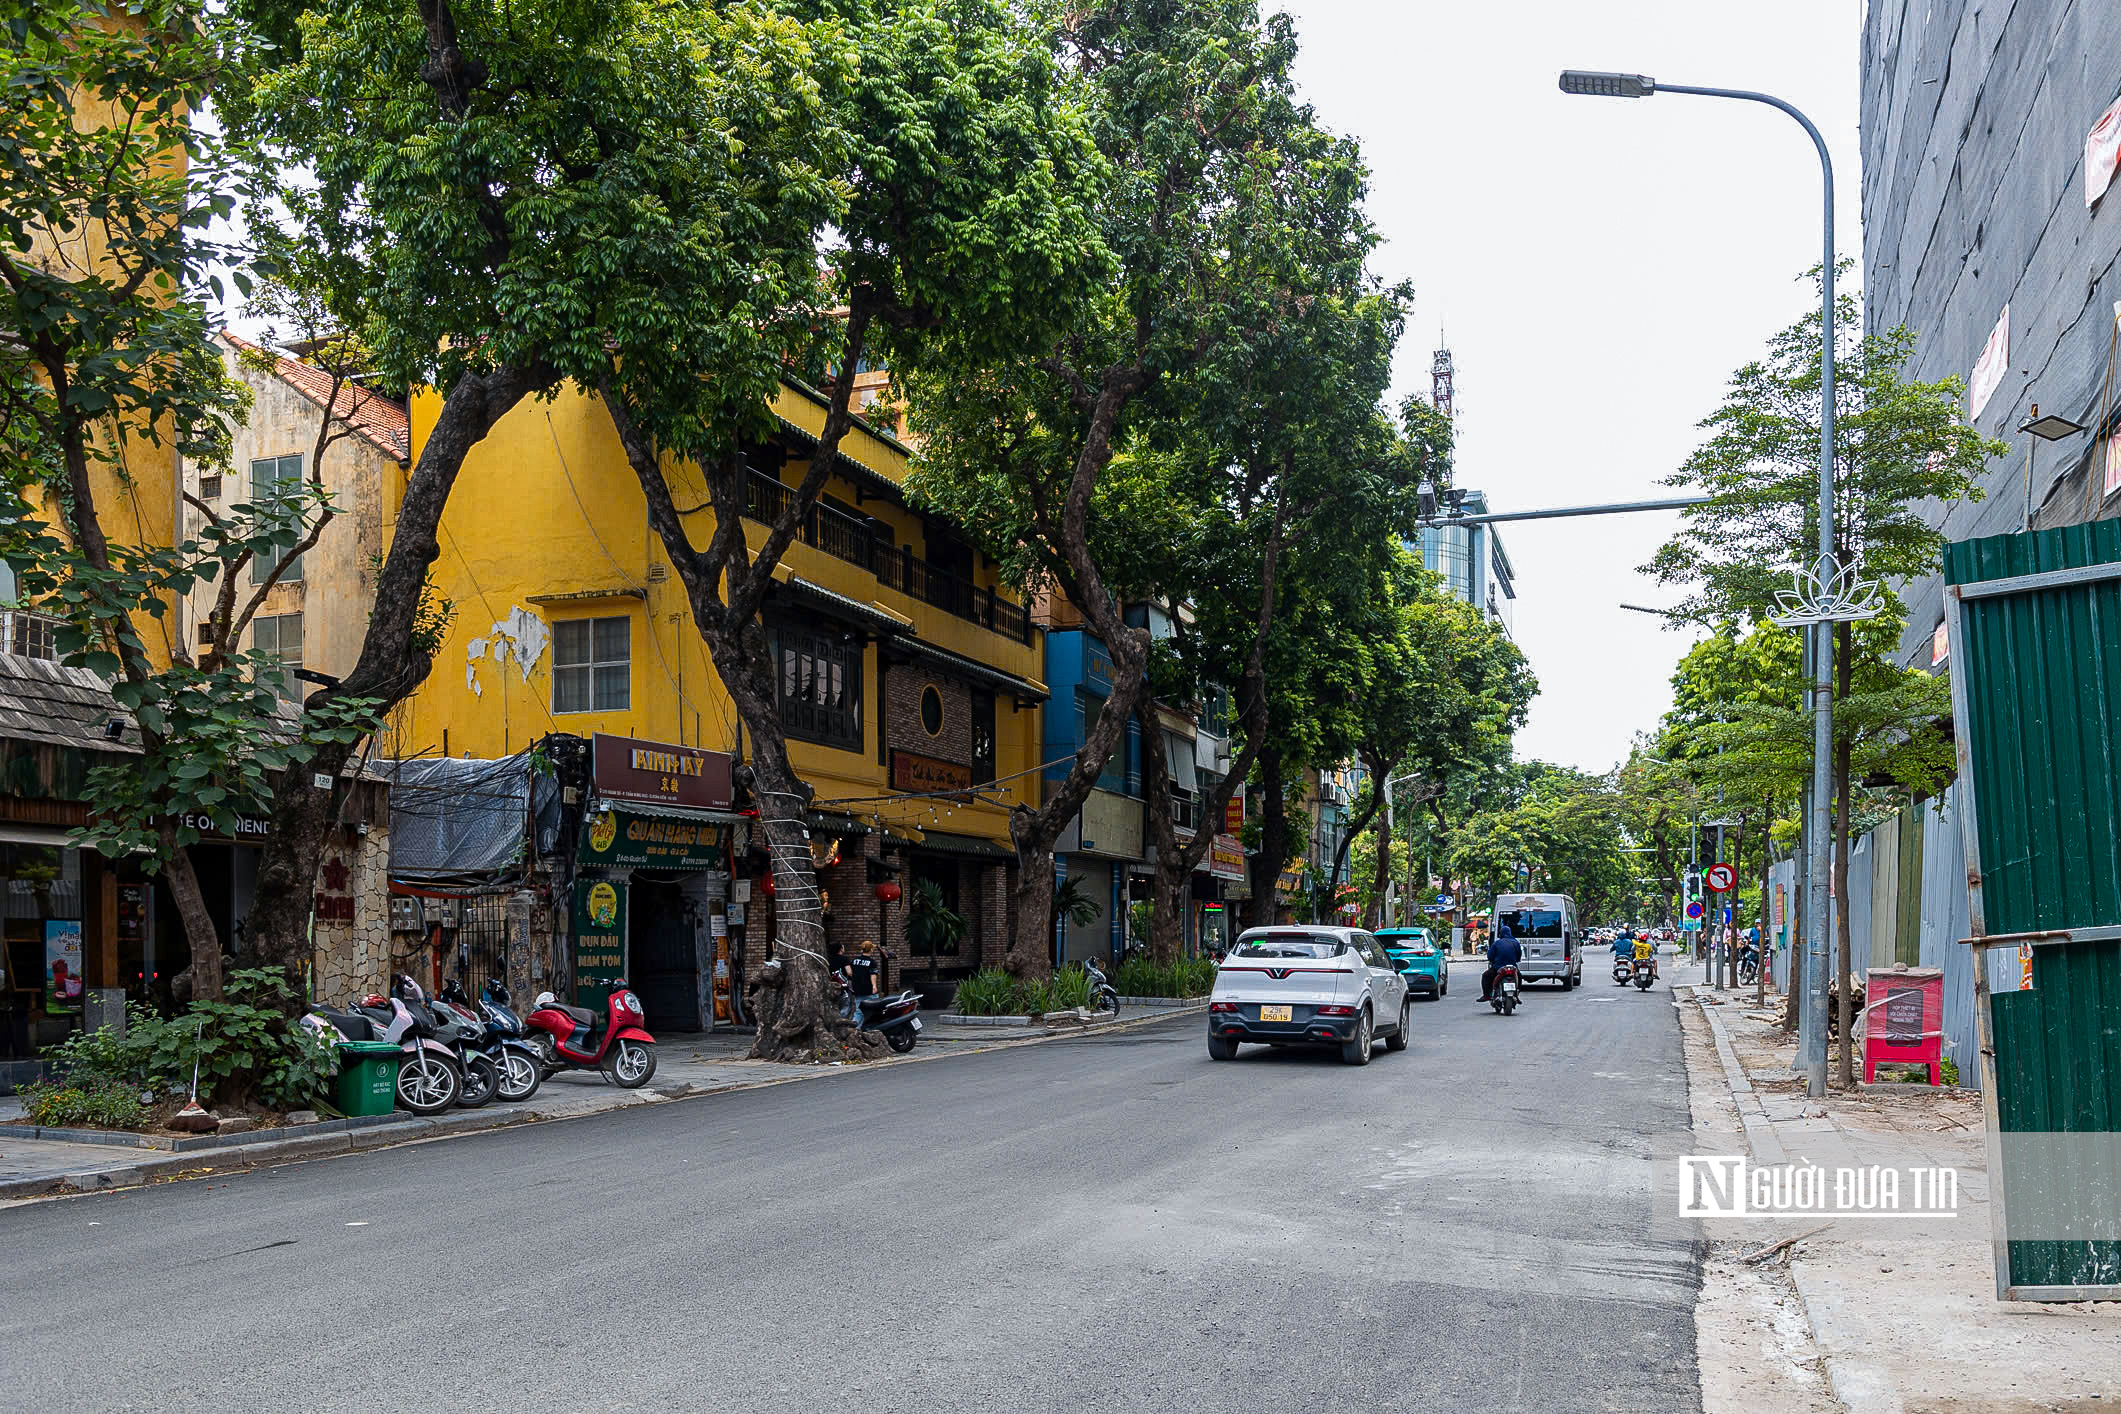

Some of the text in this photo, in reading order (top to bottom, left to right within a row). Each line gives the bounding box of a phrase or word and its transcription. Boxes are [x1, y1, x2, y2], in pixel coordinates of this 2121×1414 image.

[632, 748, 705, 777] KINH KỲ
[318, 776, 330, 784] 120
